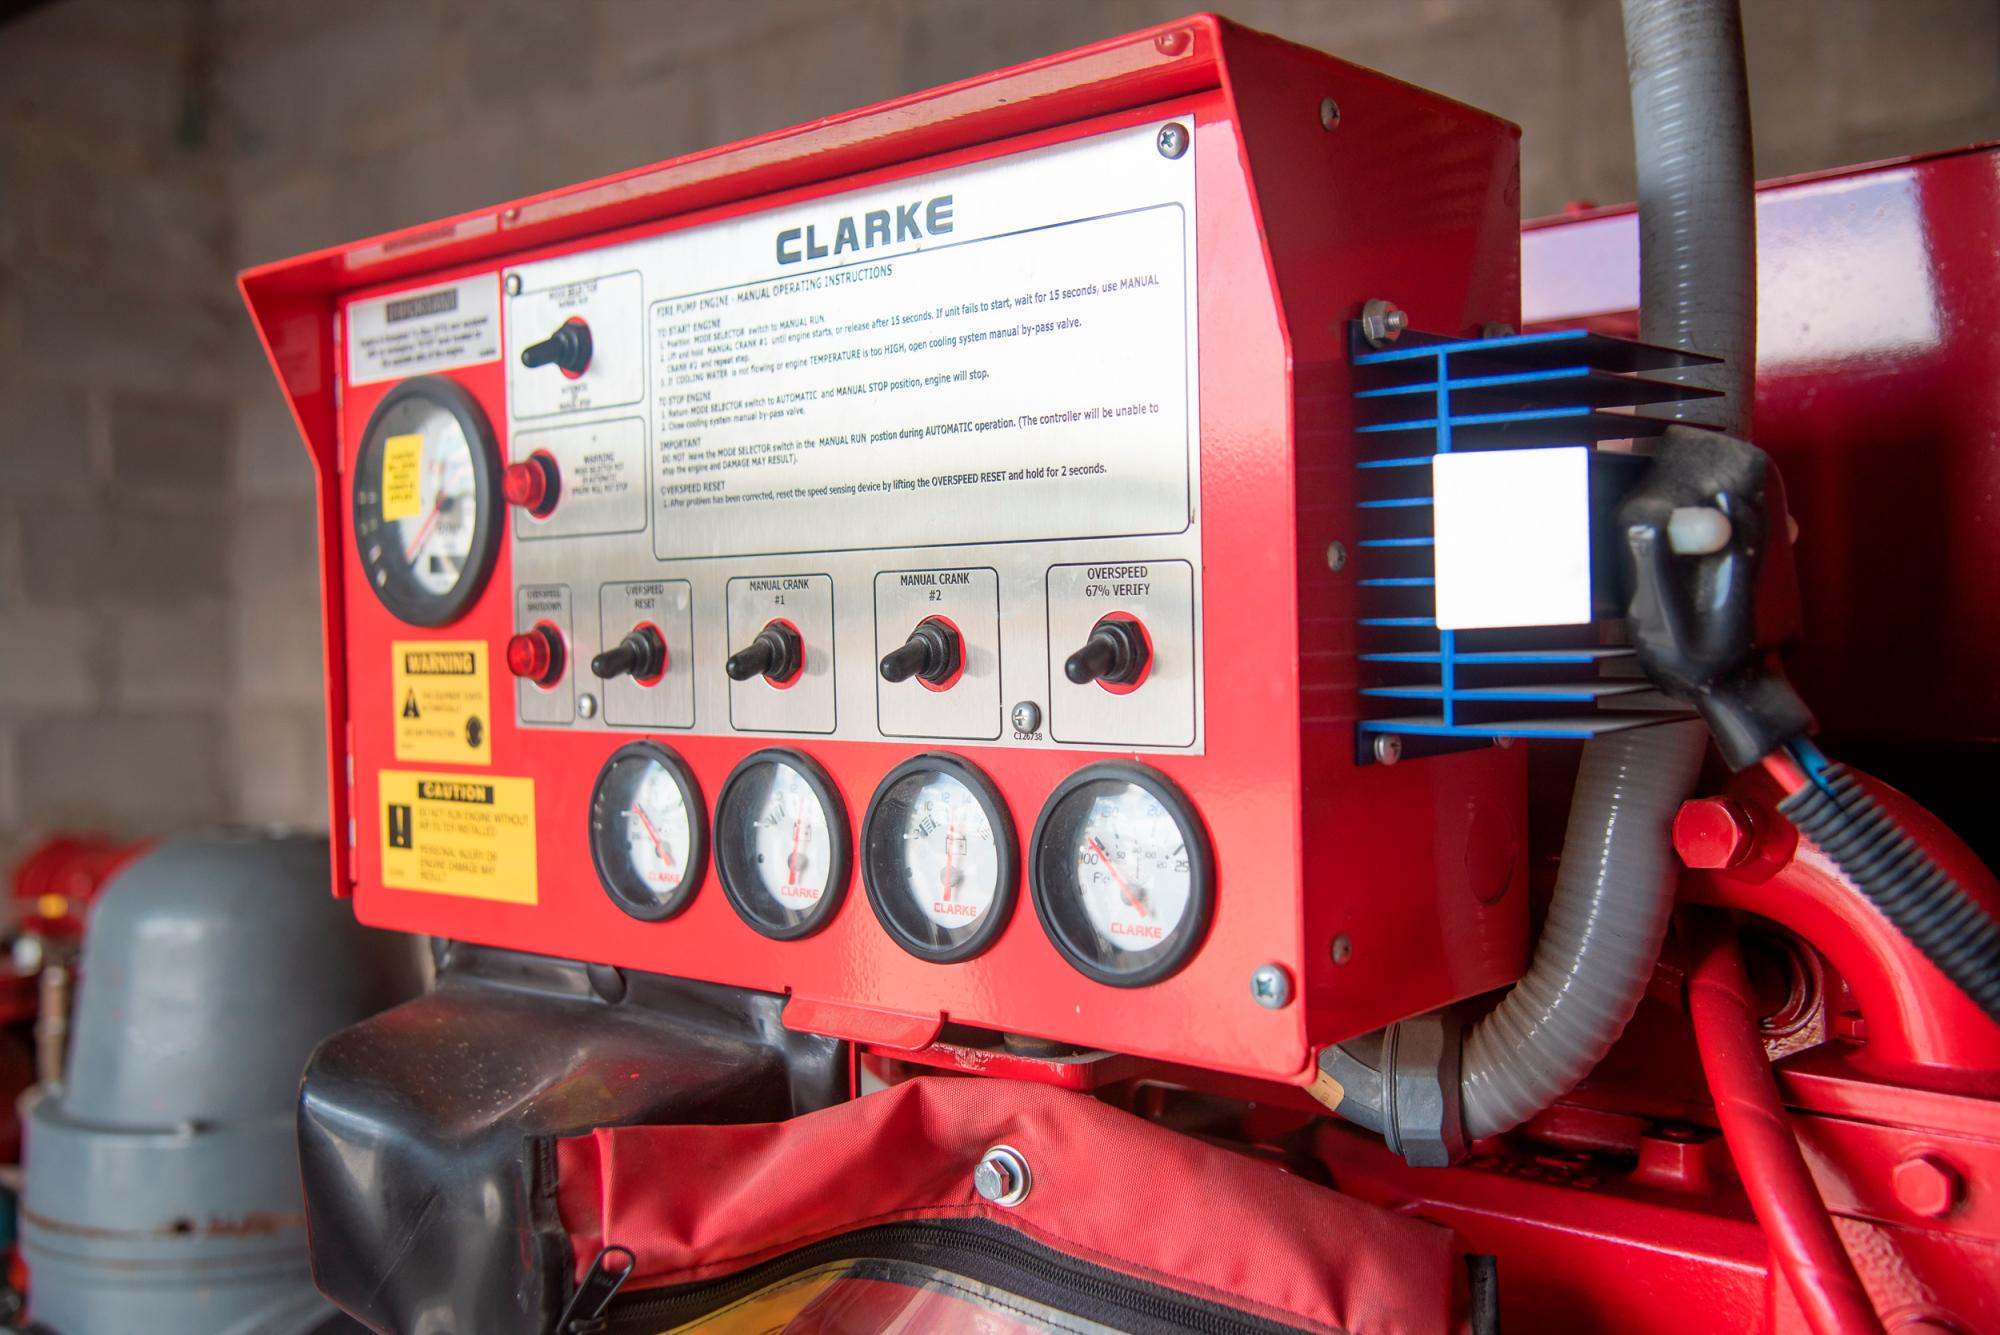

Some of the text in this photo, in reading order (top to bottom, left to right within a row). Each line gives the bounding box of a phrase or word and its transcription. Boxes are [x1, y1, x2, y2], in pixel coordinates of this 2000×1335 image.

[776, 194, 953, 265] CLARKE
[773, 277, 821, 296] OPERATING
[825, 265, 892, 287] INSTRUCTIONS
[788, 332, 810, 342] engine
[812, 327, 833, 338] starts,
[835, 326, 842, 334] or
[844, 320, 870, 333] release
[871, 317, 889, 328] after
[891, 315, 900, 325] 15
[902, 310, 933, 324] seconds.
[936, 308, 942, 318] If
[944, 305, 960, 317] unit
[961, 302, 978, 314] fails
[980, 302, 988, 311] to
[990, 297, 1012, 310] start,
[1014, 293, 1032, 306] wait
[1034, 291, 1046, 303] for
[1050, 289, 1060, 300] 15
[1062, 283, 1098, 299] seconds,
[1102, 282, 1117, 292] use
[1120, 274, 1158, 290] MANUAL
[779, 318, 807, 329] MANUAL
[785, 359, 808, 370] engine
[810, 349, 860, 365] TEMPERATURE
[870, 346, 882, 356] too
[884, 342, 906, 354] HIGH,
[908, 341, 927, 352] open
[928, 334, 956, 348] cooling
[959, 331, 987, 345] system
[989, 325, 1019, 339] manual
[1021, 320, 1054, 336] by-pass
[1057, 316, 1081, 330] valve.
[776, 390, 817, 404] AUTOMATIC
[821, 388, 834, 398] and
[836, 384, 866, 396] MANUAL
[868, 381, 888, 392] STOP
[890, 376, 922, 391] position,
[924, 372, 951, 386] engine
[953, 370, 967, 381] will
[969, 368, 989, 380] stop.
[786, 406, 806, 416] valve.
[772, 441, 794, 452] switch
[795, 440, 802, 449] in
[804, 439, 815, 448] the
[819, 435, 848, 447] MANUAL
[850, 433, 866, 444] RUN
[870, 430, 897, 444] postion
[899, 427, 924, 439] during
[925, 422, 972, 436] AUTOMATIC
[974, 417, 1016, 432] operation.
[1018, 414, 1038, 429] (The
[1039, 410, 1081, 424] controller
[1084, 408, 1100, 419] will
[1102, 407, 1113, 418] be
[1115, 403, 1146, 416] unable
[1149, 403, 1158, 413] to
[767, 453, 798, 466] RESULT).
[724, 494, 740, 503] been
[742, 490, 774, 501] corrected,
[776, 489, 793, 499] reset
[794, 488, 806, 497] the
[807, 486, 828, 497] speed
[829, 483, 856, 495] sensing
[857, 481, 881, 492] device
[882, 480, 891, 492] by
[893, 478, 916, 490] lifting
[917, 477, 930, 487] the
[931, 473, 978, 486] OVERSPEED
[980, 471, 1005, 482] RESET
[1008, 469, 1024, 480] and
[1025, 467, 1044, 479] hold
[1046, 466, 1058, 477] for
[1061, 466, 1067, 476] 2
[1068, 462, 1106, 476] seconds.
[900, 572, 970, 586] MANUAL CRANK
[1087, 566, 1148, 580] OVERSPEED
[626, 584, 664, 597] OVERSPEED
[750, 578, 809, 591] MANUAL CRANK
[1086, 583, 1150, 597] 67% VERIFY
[774, 595, 785, 605] #1
[929, 590, 942, 601] #2
[635, 598, 656, 609] RESET
[408, 654, 473, 673] WARNING
[1013, 732, 1043, 741] C126738
[423, 783, 486, 802] CAUTION
[781, 885, 819, 899] CLARKE
[934, 902, 977, 917] CLARKE
[1111, 922, 1162, 939] CLARKE
